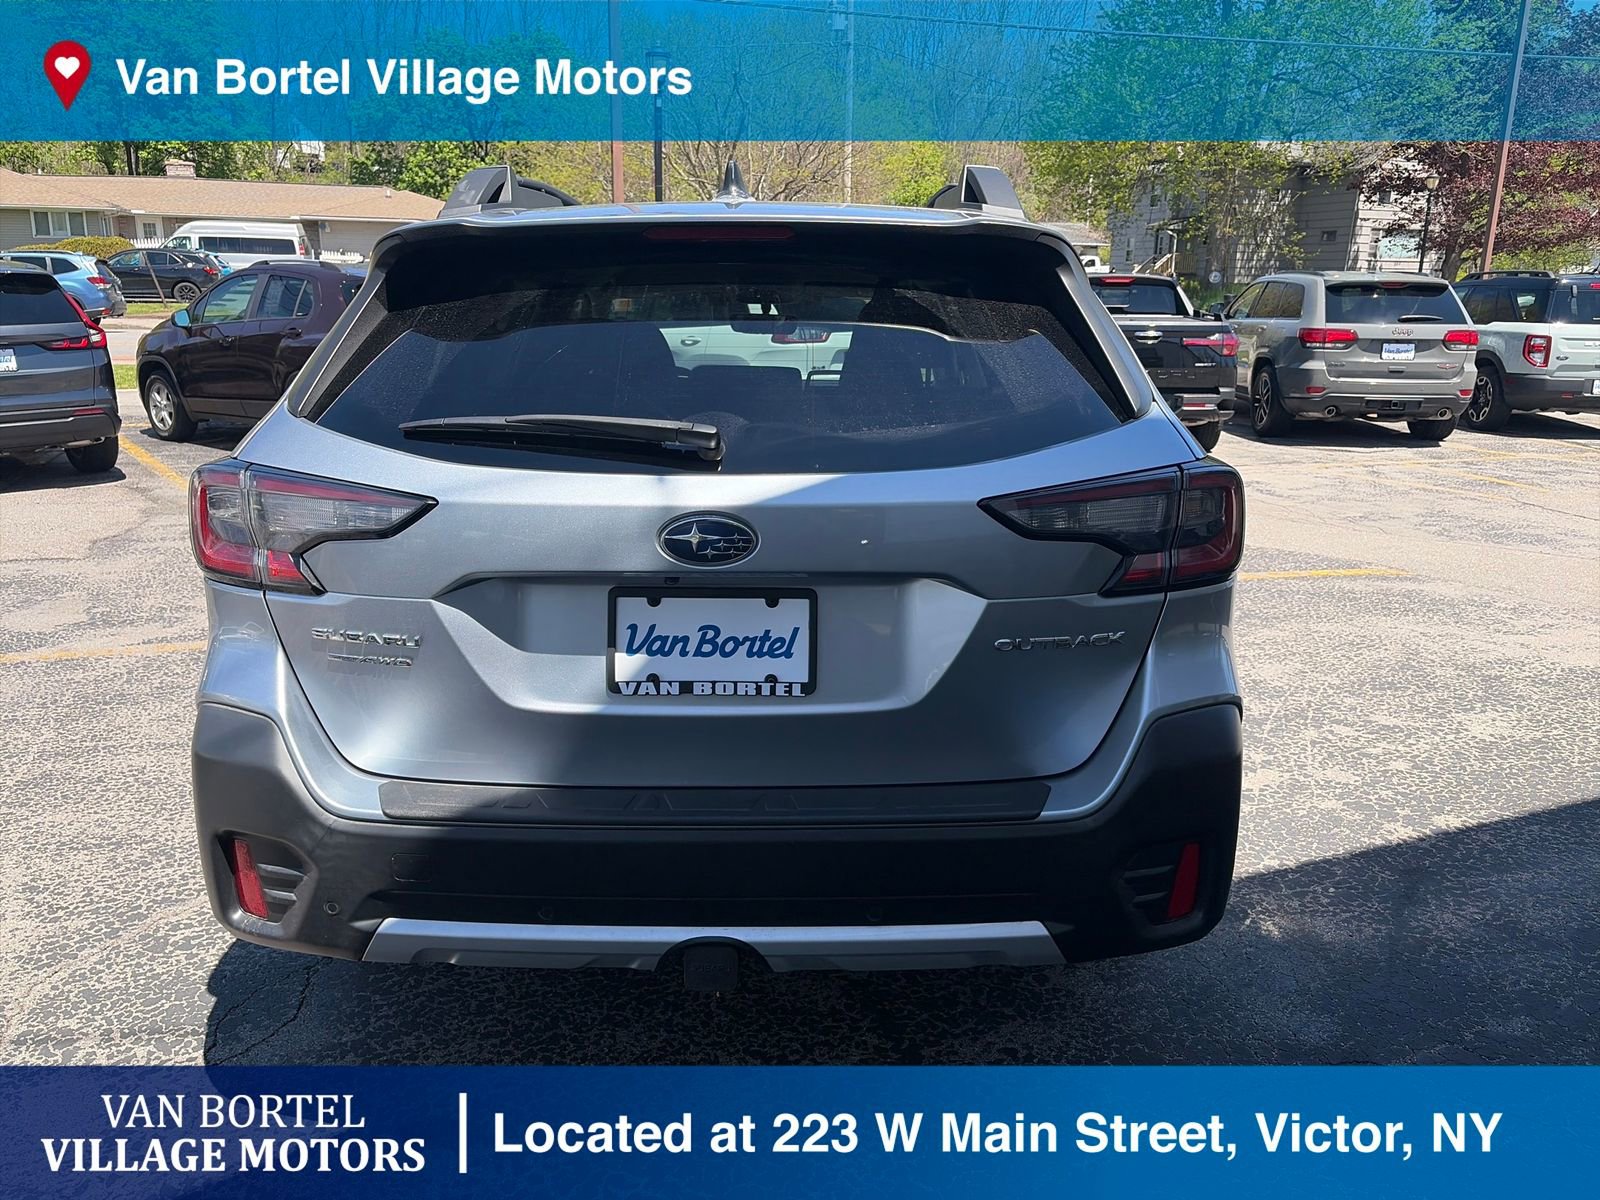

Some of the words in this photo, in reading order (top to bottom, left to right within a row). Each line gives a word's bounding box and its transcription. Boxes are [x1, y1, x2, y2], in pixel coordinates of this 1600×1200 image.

[311, 627, 420, 649] SUBARU
[626, 623, 690, 657] Van
[692, 624, 800, 659] Bortel
[994, 631, 1126, 651] OUTBACK
[360, 655, 412, 668] AWD
[618, 681, 680, 696] VAN
[693, 682, 806, 697] BORTEL
